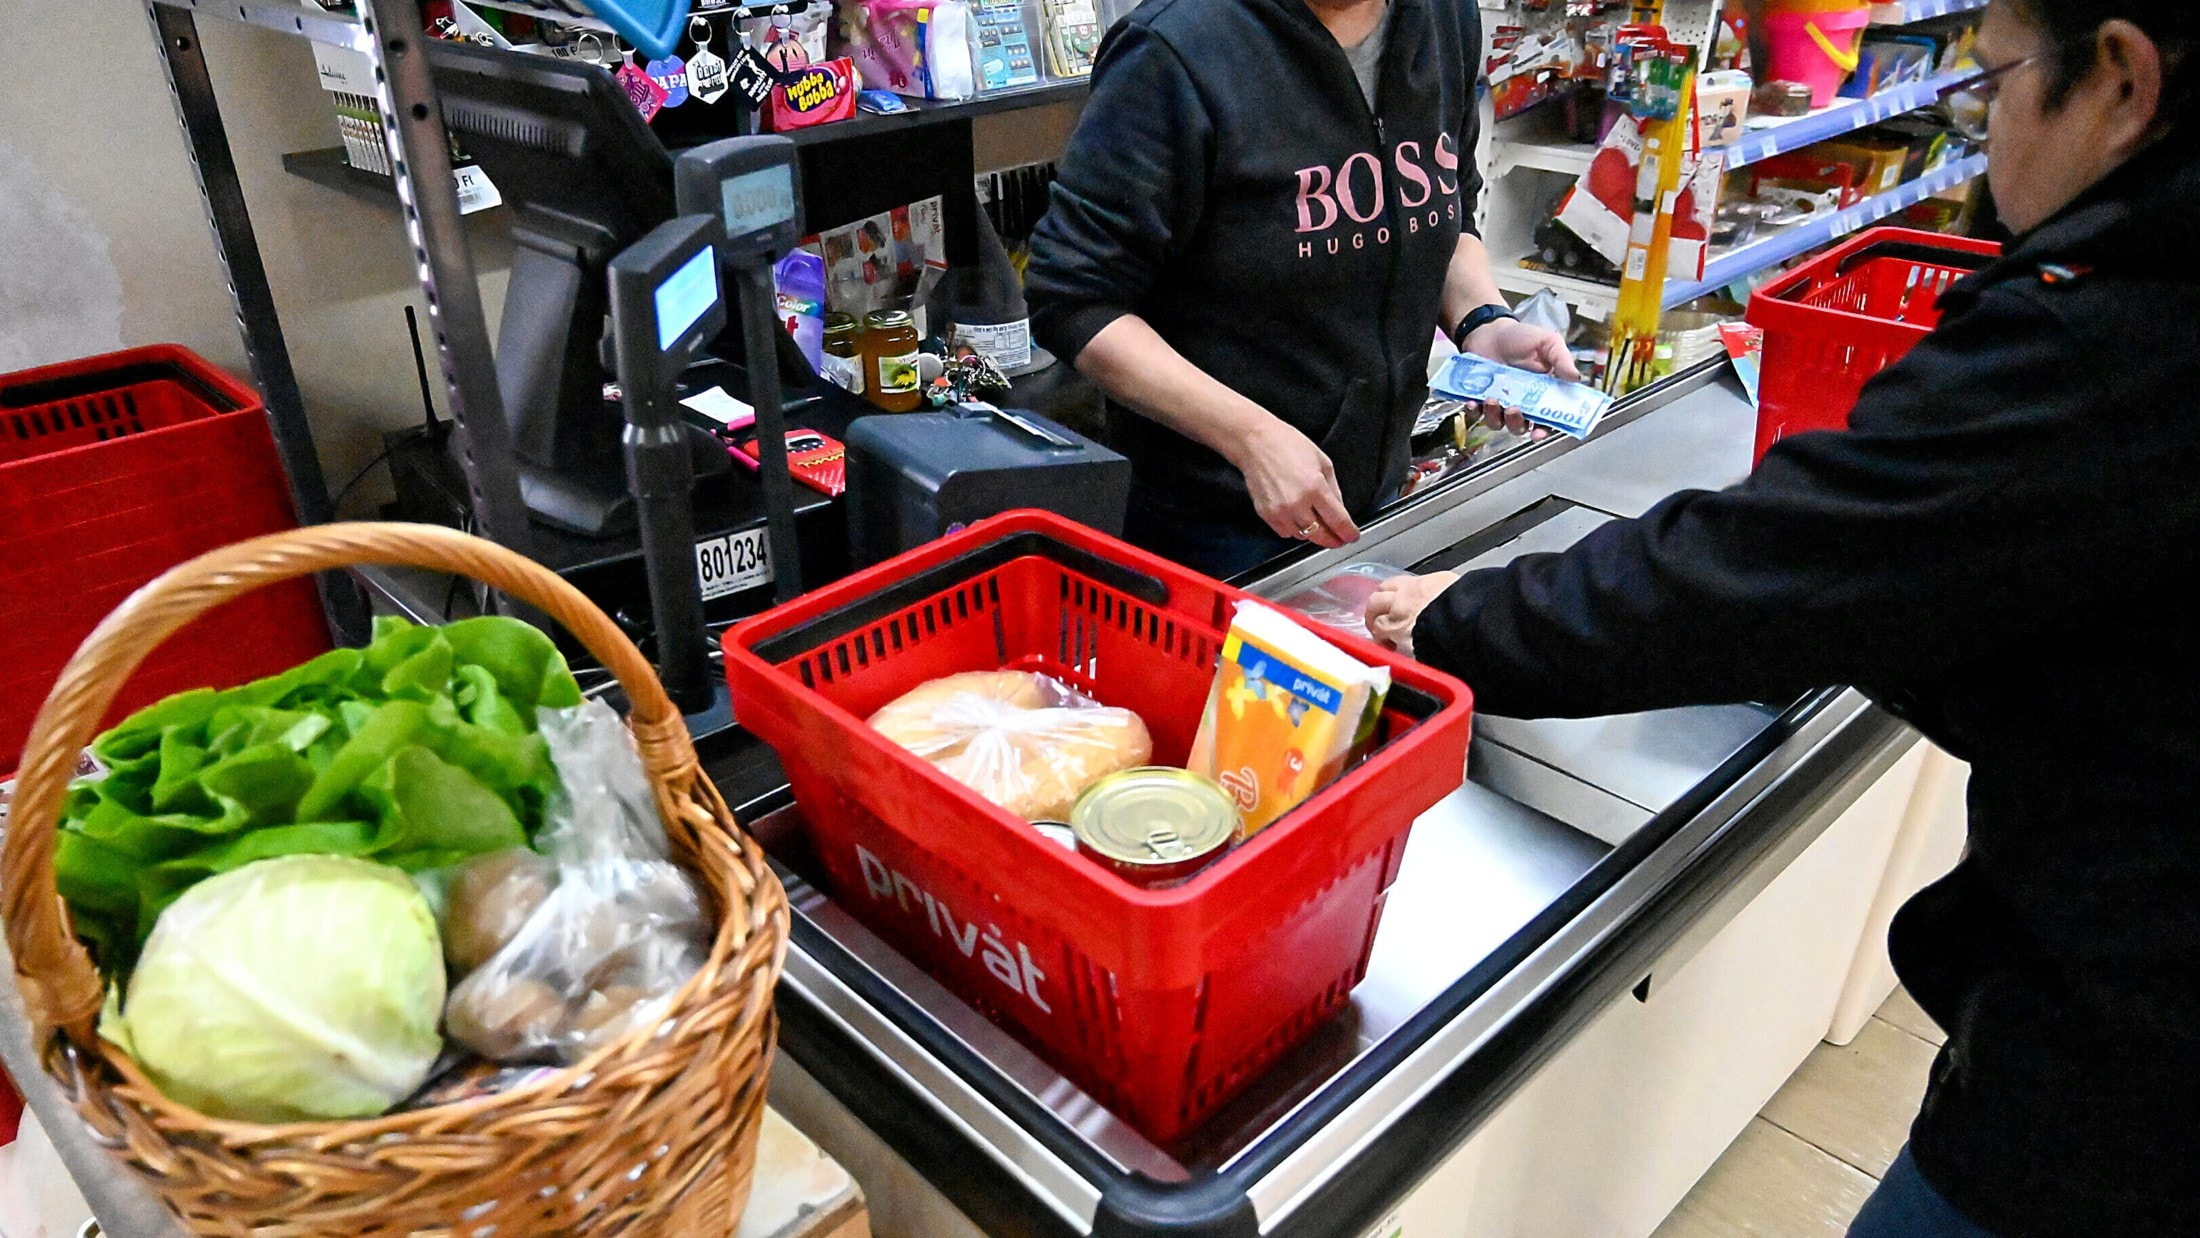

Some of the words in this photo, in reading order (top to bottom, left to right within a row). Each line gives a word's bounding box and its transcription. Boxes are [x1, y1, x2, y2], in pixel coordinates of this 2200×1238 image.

[786, 72, 824, 101] Hubba
[798, 80, 834, 112] Bubba
[1294, 132, 1459, 233] BOSS
[1298, 227, 1390, 258] HUGO
[1409, 204, 1456, 233] BOS
[776, 295, 811, 313] Color
[1539, 406, 1584, 426] 1000
[700, 532, 767, 582] 801234
[1292, 676, 1331, 705] privát
[855, 842, 1052, 1015] privát
